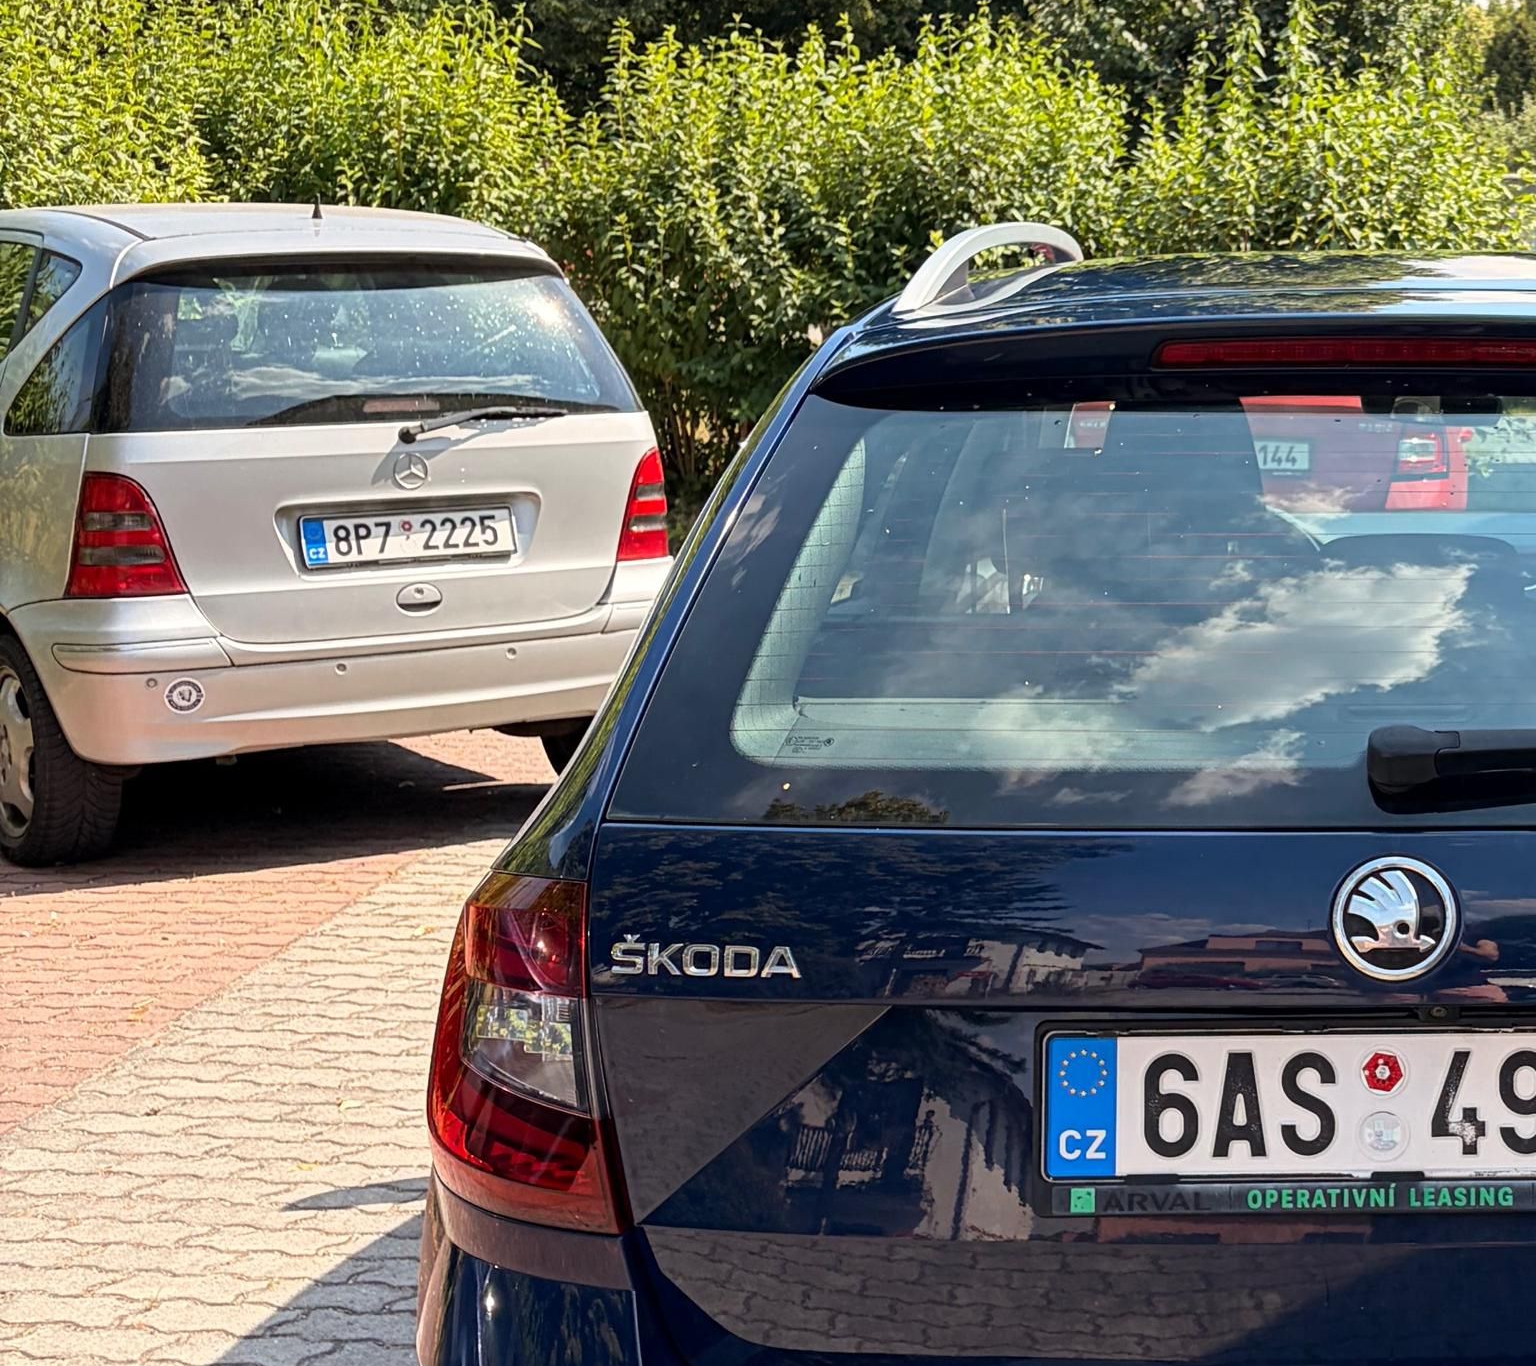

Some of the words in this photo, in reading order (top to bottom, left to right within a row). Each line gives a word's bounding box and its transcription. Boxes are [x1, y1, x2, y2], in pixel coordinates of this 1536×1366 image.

[1258, 444, 1298, 468] 144
[333, 521, 392, 557] 8P7
[419, 515, 499, 552] 2225
[308, 547, 326, 560] CZ
[610, 934, 801, 978] ŠKODA
[1143, 1053, 1337, 1158] 6AS
[1059, 1130, 1107, 1160] CZ
[1103, 1191, 1212, 1212] ARVAL
[1247, 1184, 1397, 1209] OPERATIVNÍ
[1411, 1185, 1514, 1207] LEASING
